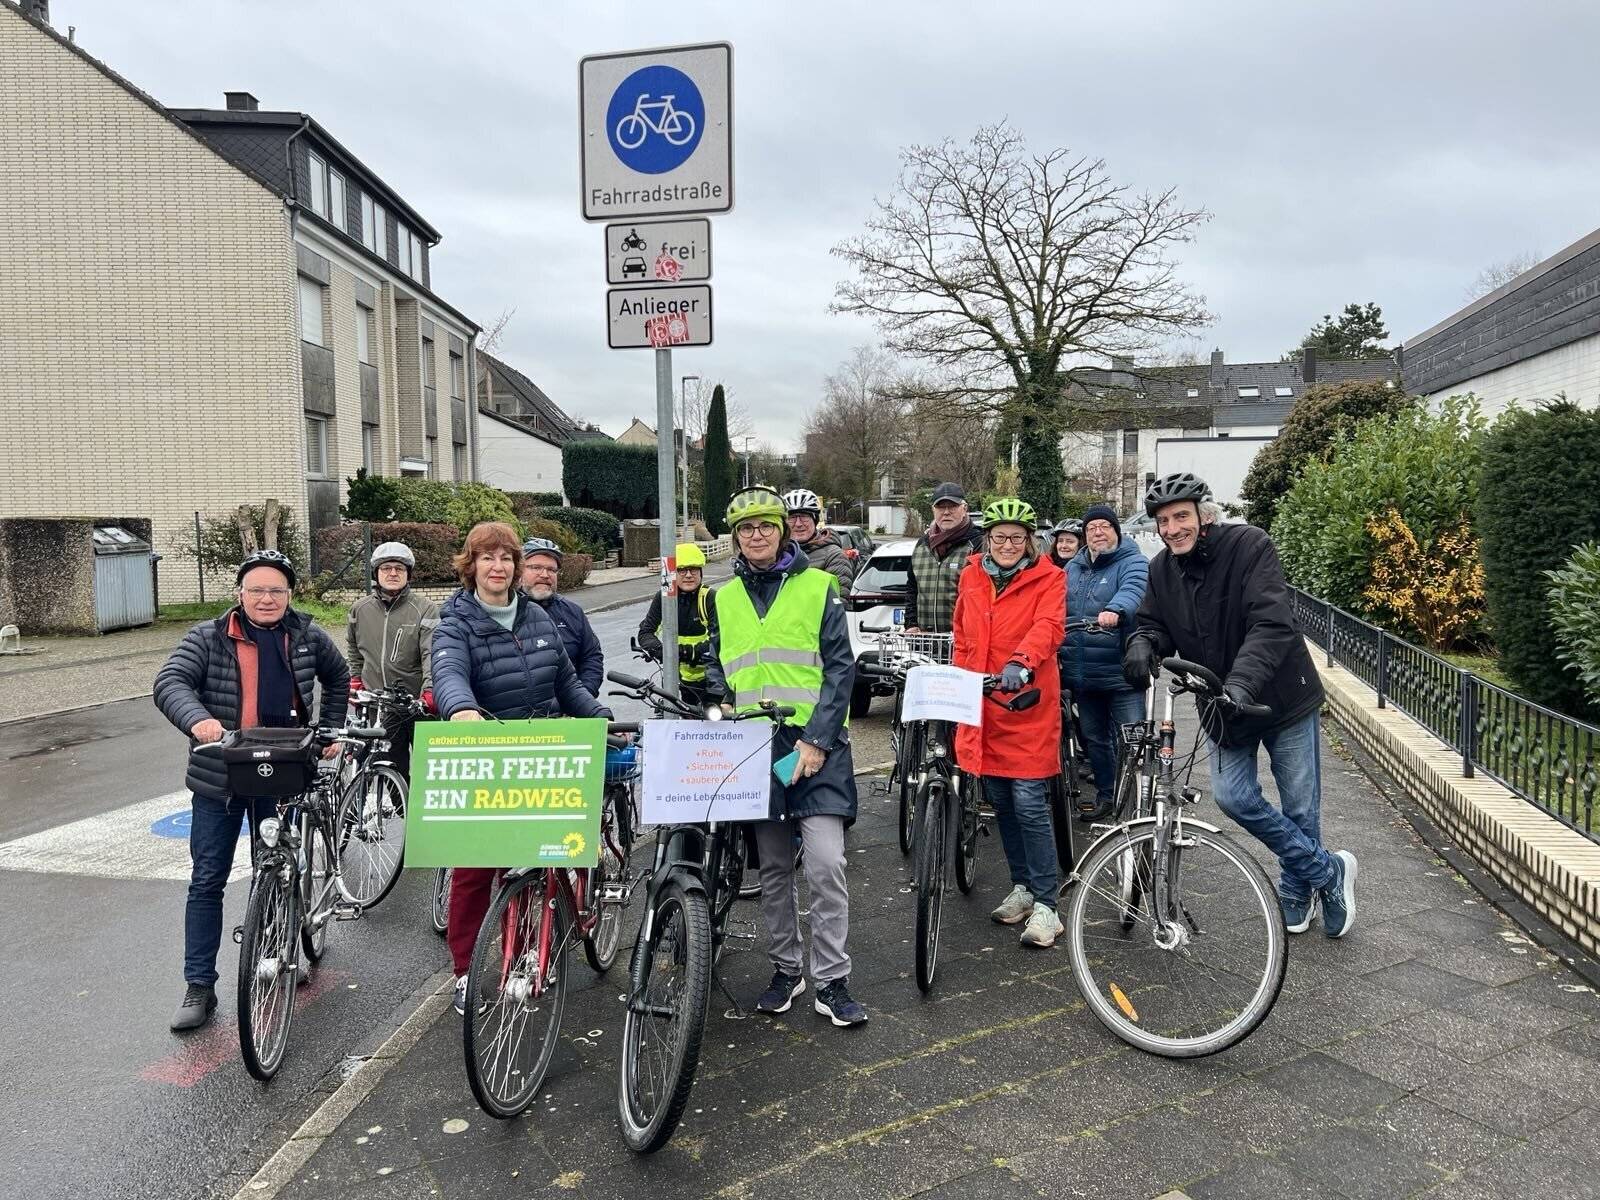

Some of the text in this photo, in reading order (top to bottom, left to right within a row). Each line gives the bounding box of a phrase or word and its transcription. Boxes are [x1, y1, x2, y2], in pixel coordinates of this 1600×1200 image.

[592, 182, 722, 206] Fahrradstraße
[661, 241, 695, 260] frei
[619, 297, 699, 316] Anlieger
[428, 735, 566, 746] GRÜNE FÜR UNSEREN STADTTEIL
[674, 731, 743, 741] Fahrradstraßen
[702, 749, 724, 758] Ruhe
[426, 756, 591, 781] HIER FEHLT
[691, 762, 734, 771] Sicherheit
[686, 776, 720, 785] saubere
[423, 787, 588, 810] EIN RADWEG.
[665, 793, 691, 802] deine
